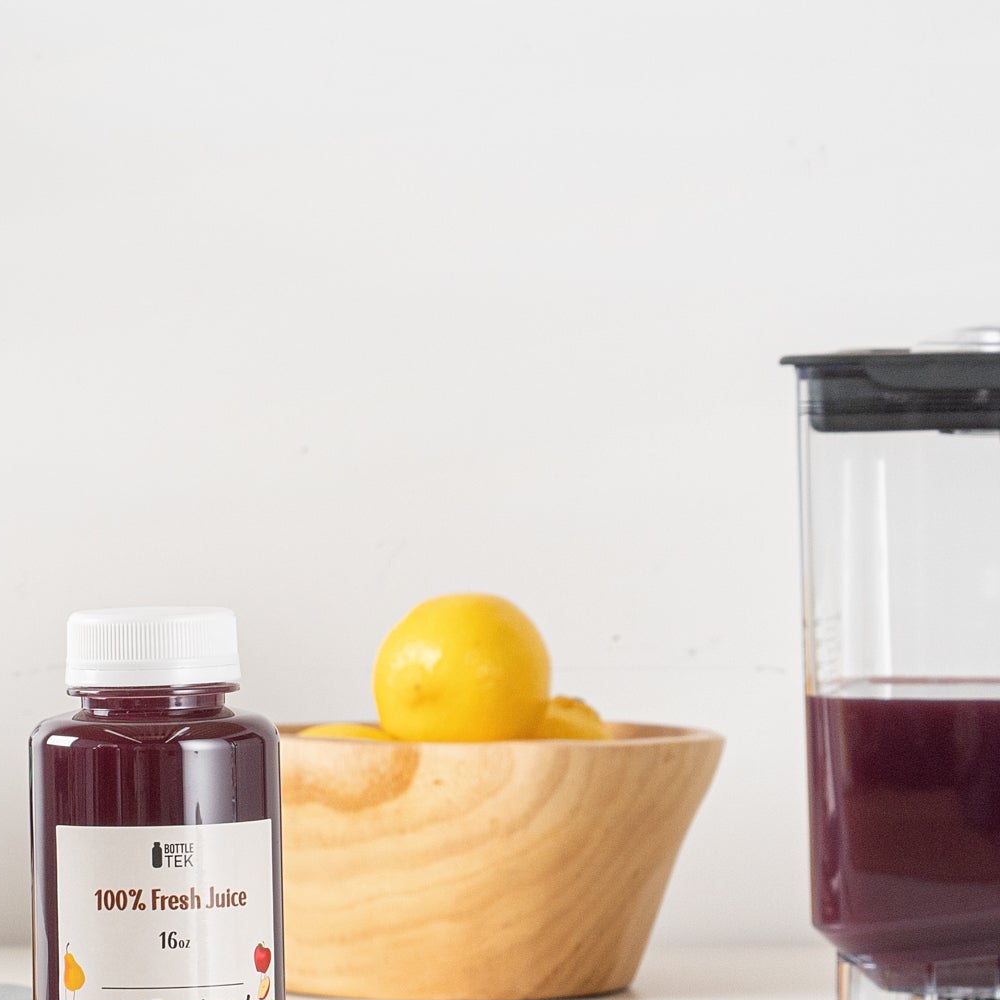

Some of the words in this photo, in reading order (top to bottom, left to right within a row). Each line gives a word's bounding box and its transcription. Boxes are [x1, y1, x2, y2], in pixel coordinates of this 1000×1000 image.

[164, 842, 195, 854] BOTTLE
[164, 854, 195, 868] TEK
[94, 888, 147, 911] 100%
[151, 886, 202, 911] Fresh
[205, 885, 248, 909] Juice
[158, 931, 191, 950] 16oz
